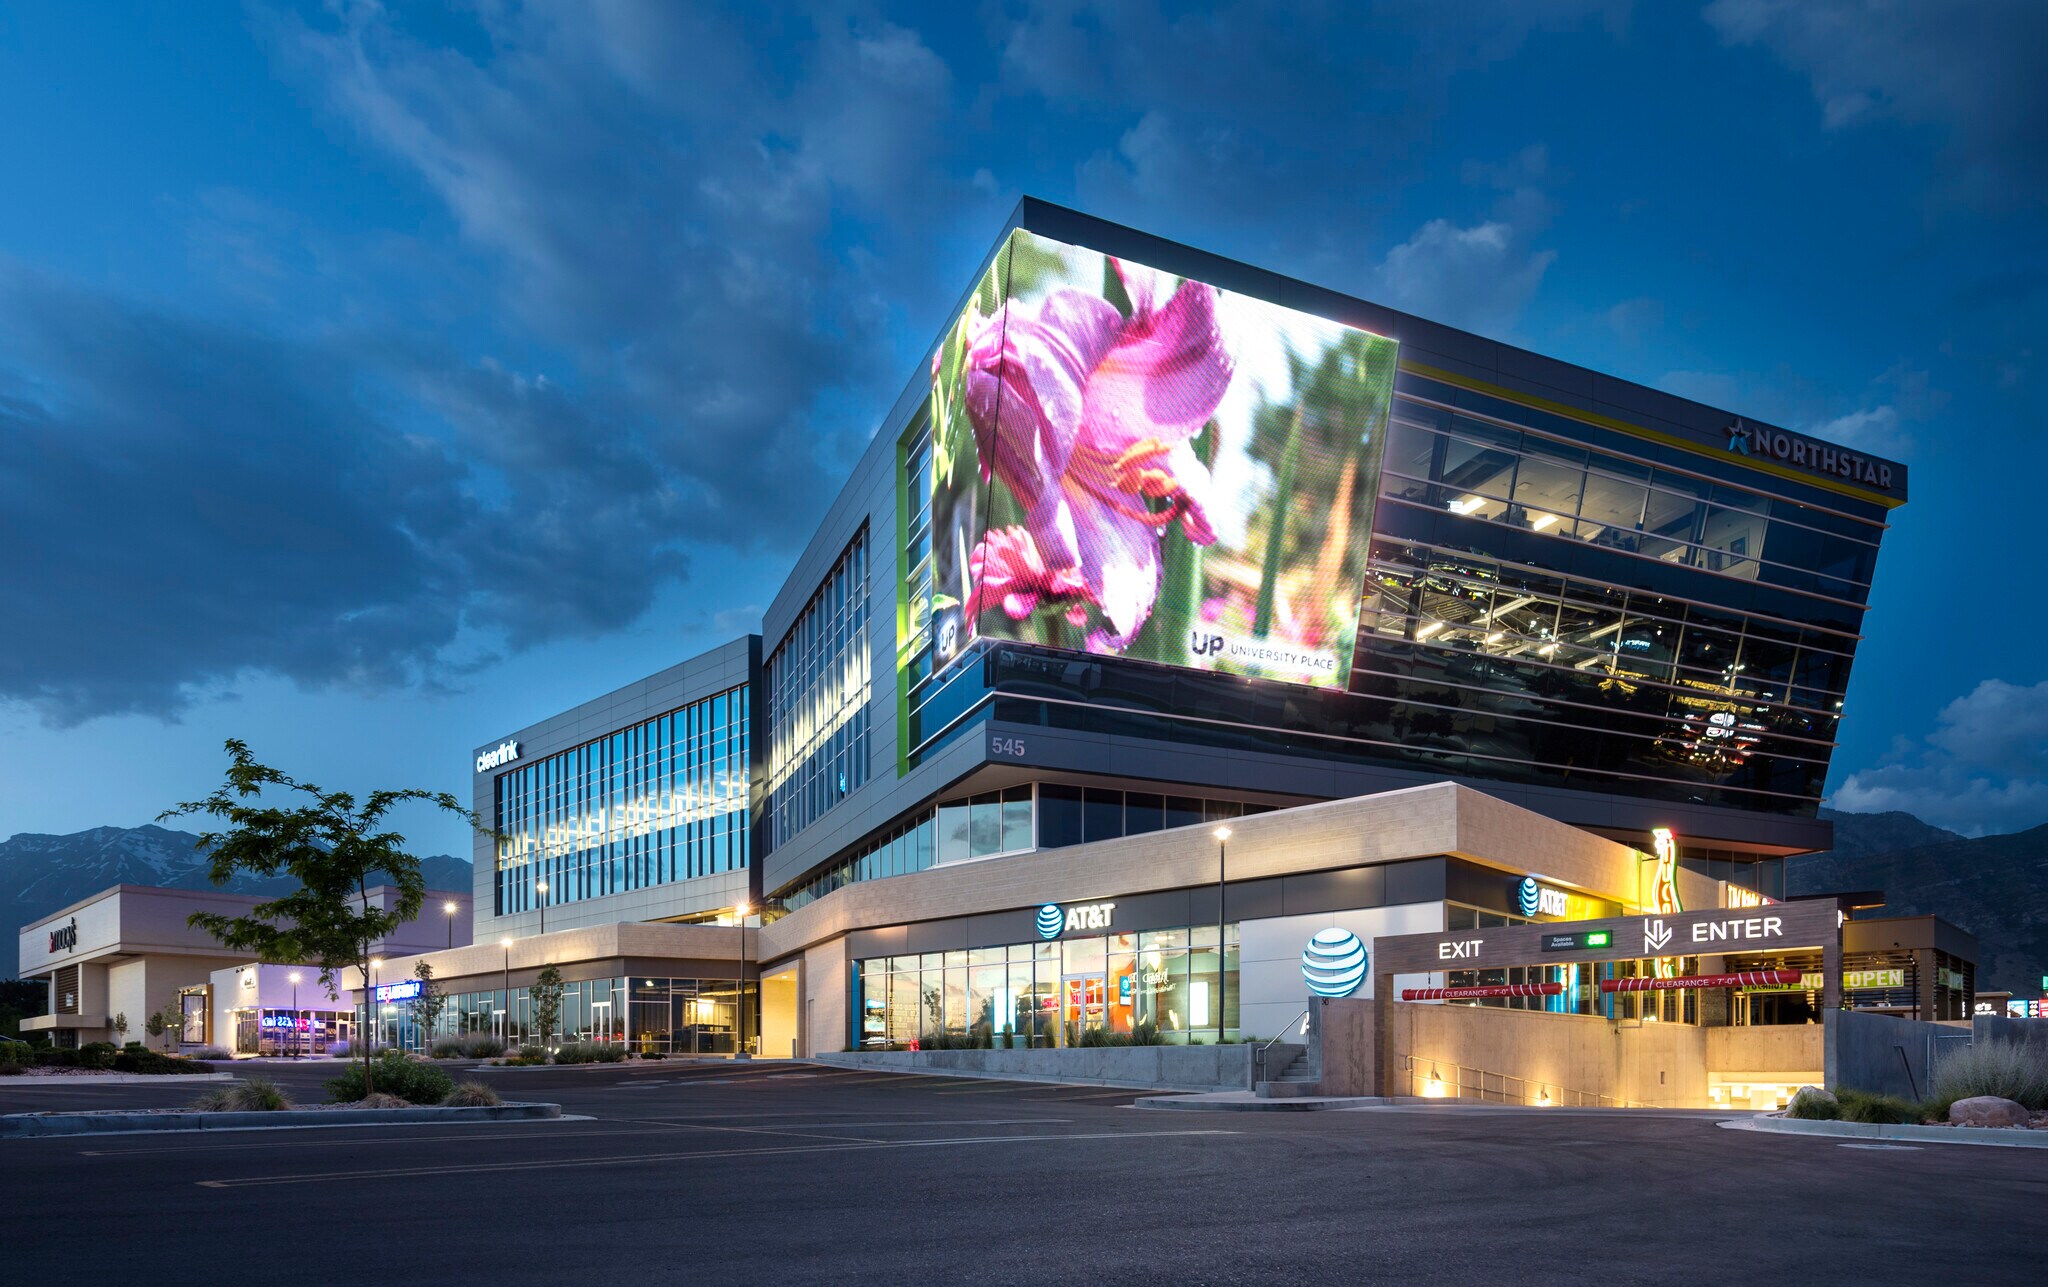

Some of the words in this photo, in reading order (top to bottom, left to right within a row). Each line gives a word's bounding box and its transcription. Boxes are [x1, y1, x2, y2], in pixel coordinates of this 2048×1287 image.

[1755, 427, 1892, 488] NORTHSTAR
[1191, 631, 1225, 657] UP
[1230, 643, 1298, 665] UNIVERSITY
[1301, 655, 1334, 671] PLACE
[476, 739, 519, 773] clearlink
[992, 736, 1025, 757] 545
[1539, 888, 1568, 917] AT&T
[1064, 903, 1116, 931] AT&T
[1692, 916, 1783, 942] ENTER
[1439, 940, 1483, 959] EXIT
[1655, 979, 1710, 989] CLEARANCE
[1800, 973, 1824, 989] NO
[1849, 969, 1901, 987] OPEN
[1445, 989, 1488, 998] CLEARANCE
